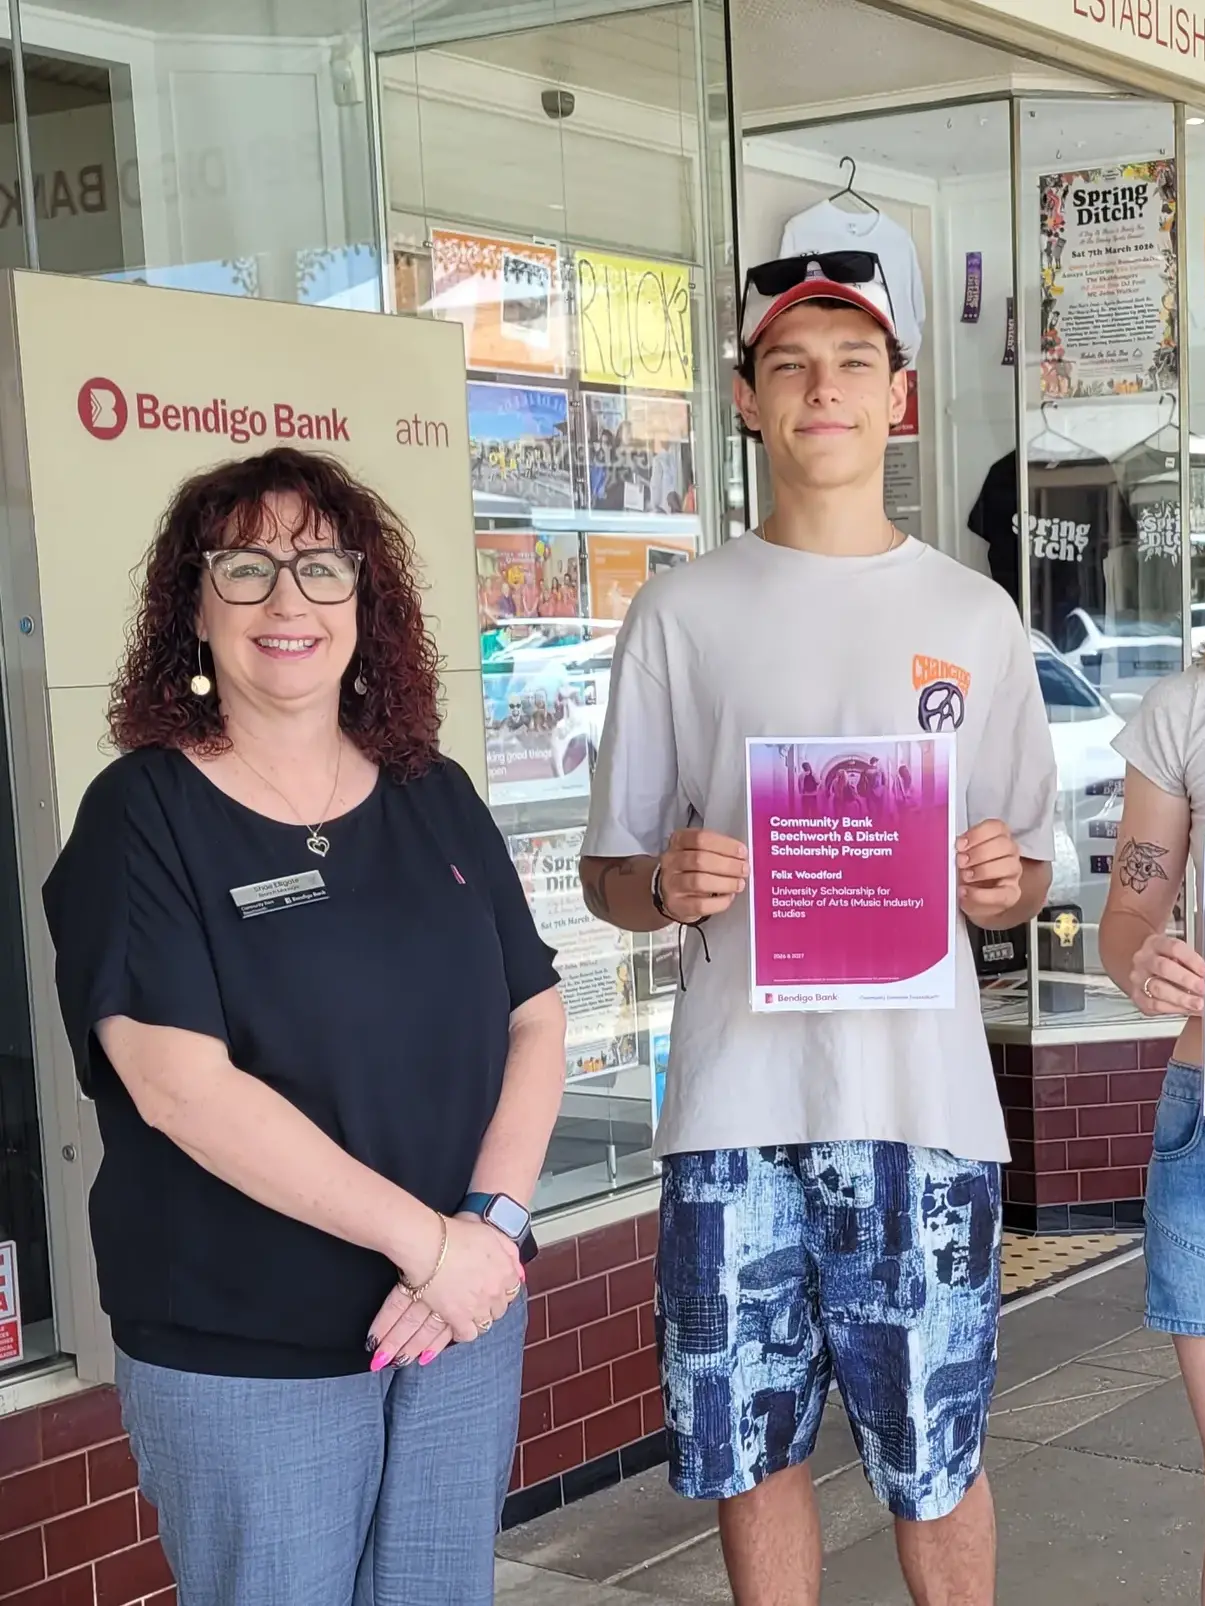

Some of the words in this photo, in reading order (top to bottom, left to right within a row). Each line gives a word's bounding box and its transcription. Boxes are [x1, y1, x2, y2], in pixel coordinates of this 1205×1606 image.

[1073, 183, 1149, 207] Spring
[1077, 202, 1144, 226] Ditch!
[1072, 250, 1086, 259] Sat
[1088, 248, 1103, 258] 7th
[1105, 246, 1132, 255] March
[1134, 243, 1154, 252] 2026
[136, 392, 268, 443] Bendigo
[273, 403, 350, 442] Bank
[396, 413, 449, 447] atm
[770, 816, 840, 830] Community
[842, 816, 872, 828] Bank
[770, 830, 841, 842] Beechworth
[844, 831, 854, 842] &
[856, 830, 899, 842] District
[771, 845, 840, 858] Scholarship
[842, 846, 892, 858] Program
[772, 870, 792, 880] Felix
[795, 870, 842, 880] Woodford
[772, 886, 818, 897] University
[820, 886, 875, 897] Scholarship
[877, 886, 890, 896] for
[772, 898, 814, 907] Bachelor
[816, 898, 826, 907] of
[828, 898, 849, 907] Arts
[850, 898, 882, 908] (Music
[884, 898, 924, 908] Industry)
[772, 910, 806, 918] studies
[778, 994, 814, 1004] Bendigo
[816, 993, 838, 1002] Bank
